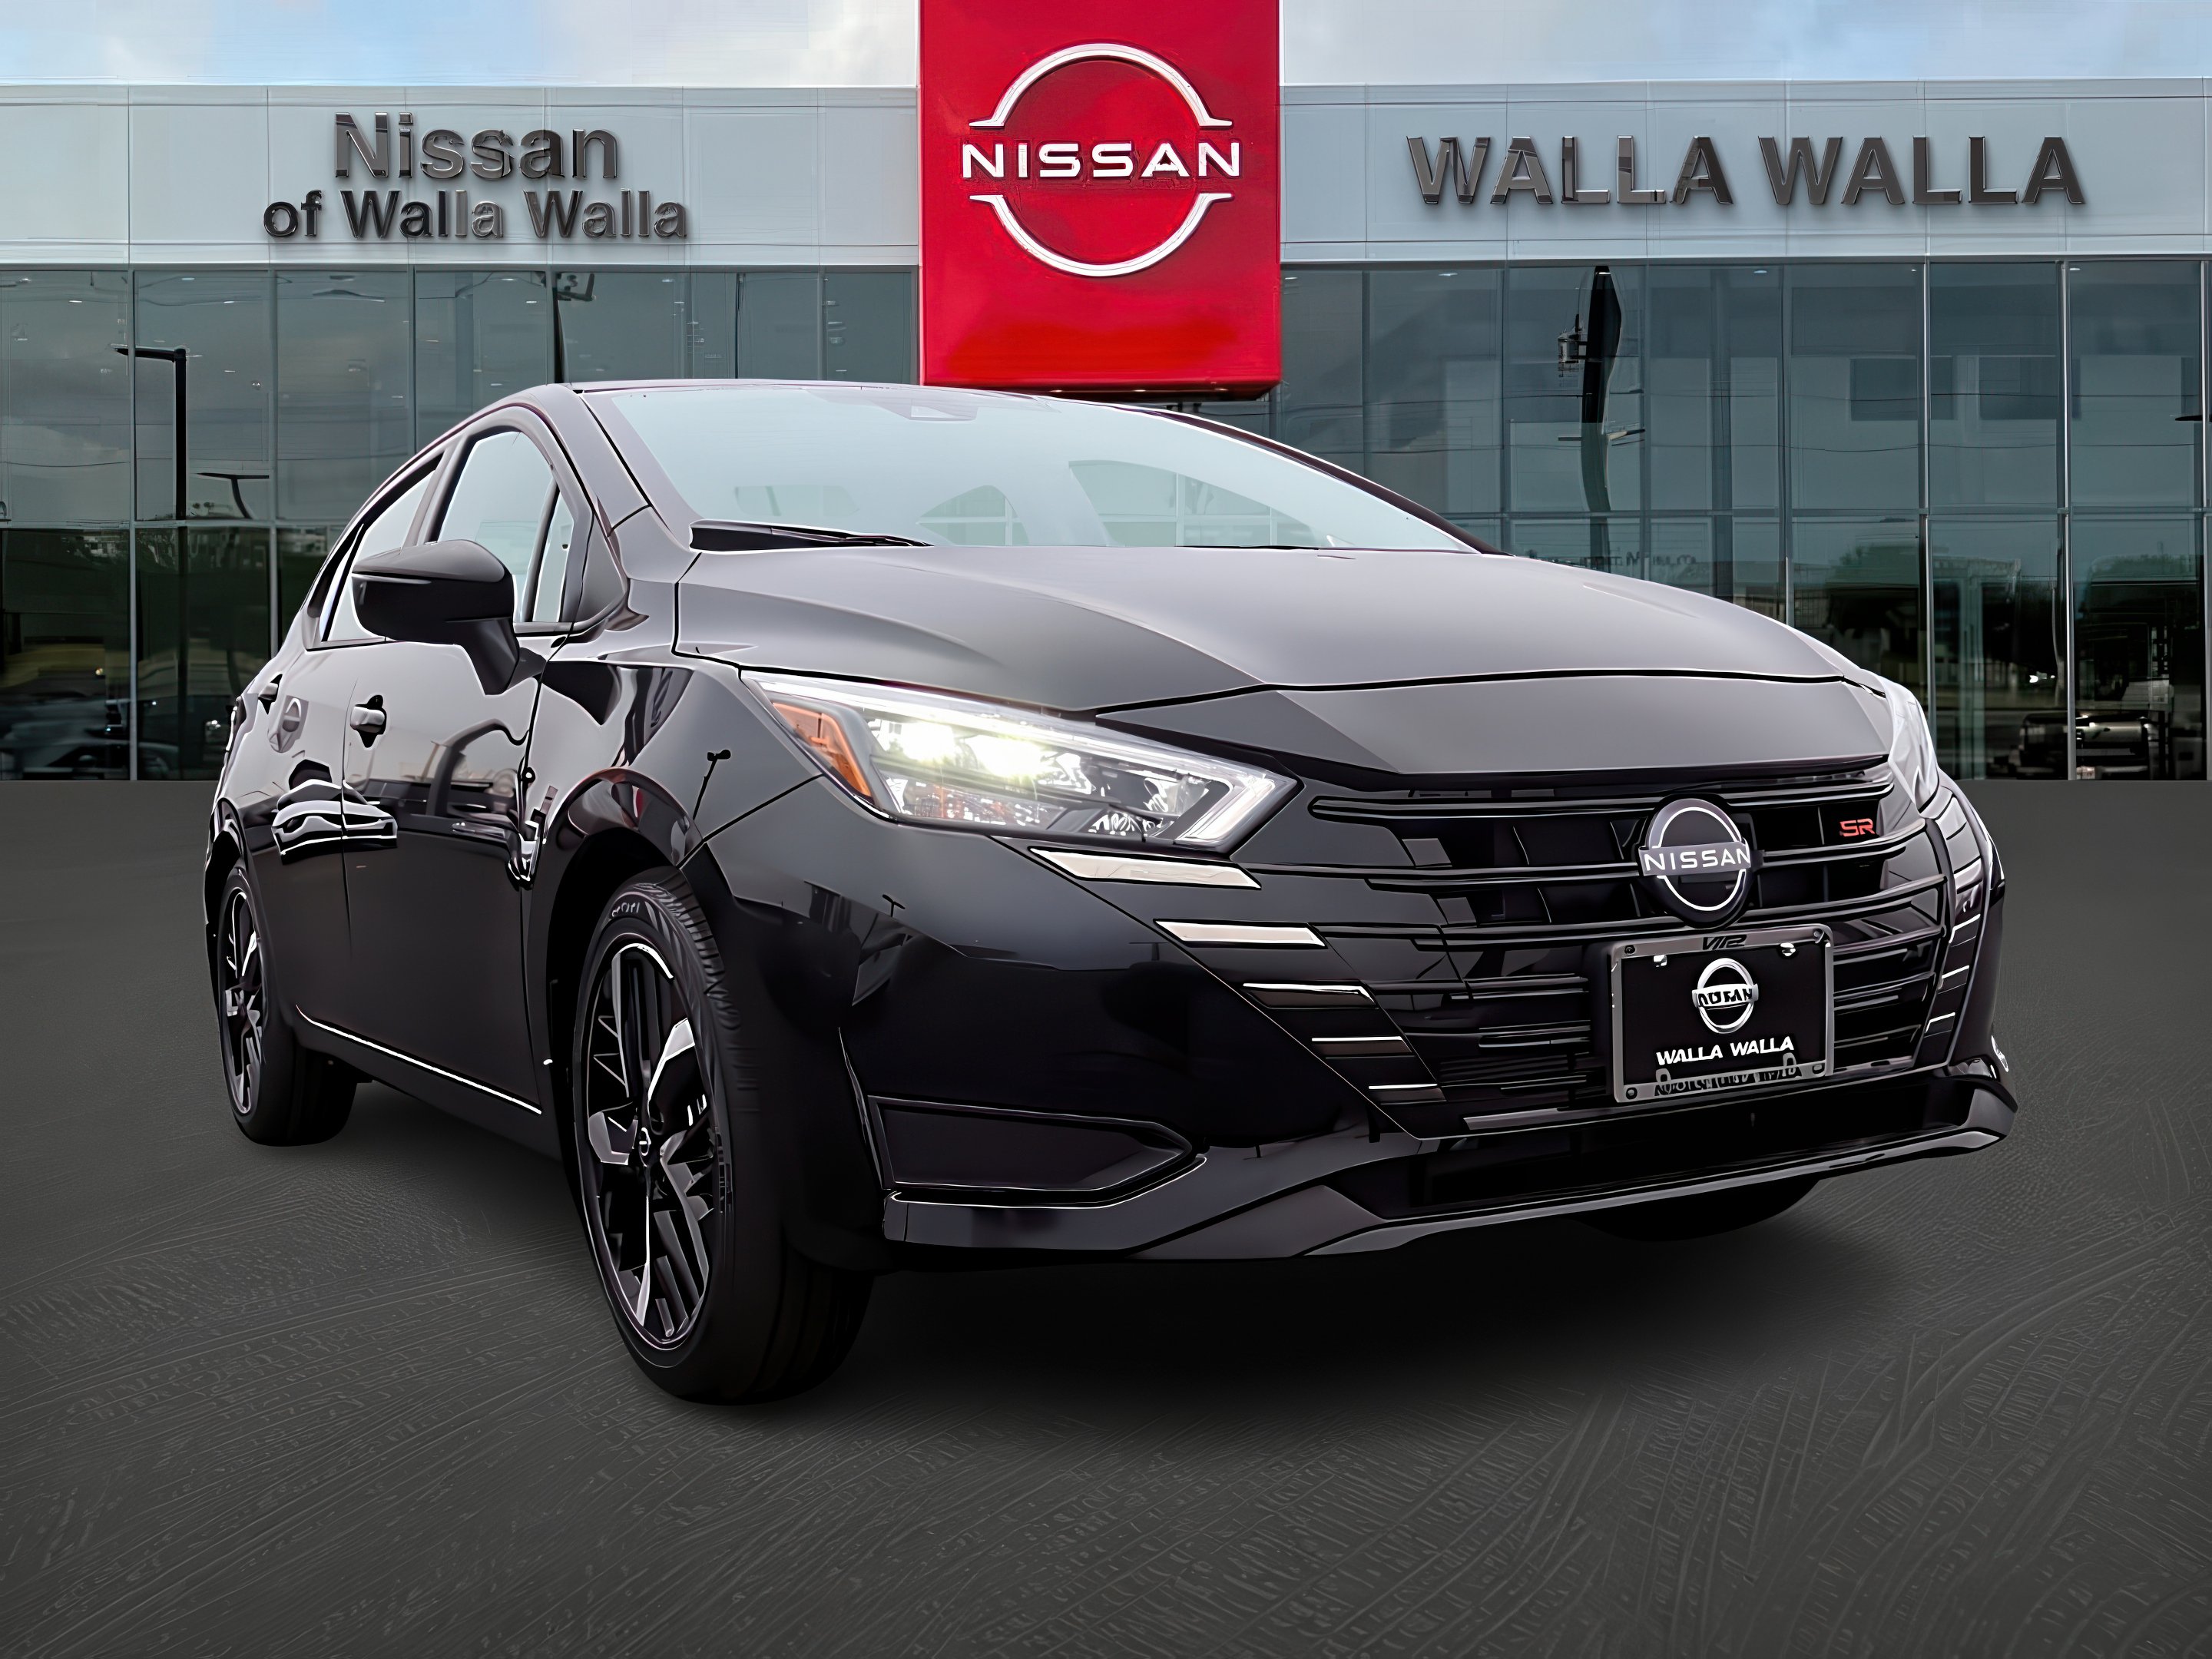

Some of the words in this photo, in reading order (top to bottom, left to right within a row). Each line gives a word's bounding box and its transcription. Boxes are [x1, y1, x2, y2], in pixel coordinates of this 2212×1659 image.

[335, 111, 618, 180] Nissan
[962, 141, 1240, 178] NISSAN
[1406, 135, 1734, 205] WALLA
[1758, 135, 2086, 205] WALLA
[263, 189, 323, 237] of
[339, 189, 504, 238] Walla
[523, 189, 687, 238] Walla
[1839, 818, 1876, 837] SR
[1644, 847, 1751, 871] NISSAN
[1656, 1045, 1723, 1065] WALLA
[1730, 1036, 1795, 1057] WALLA
